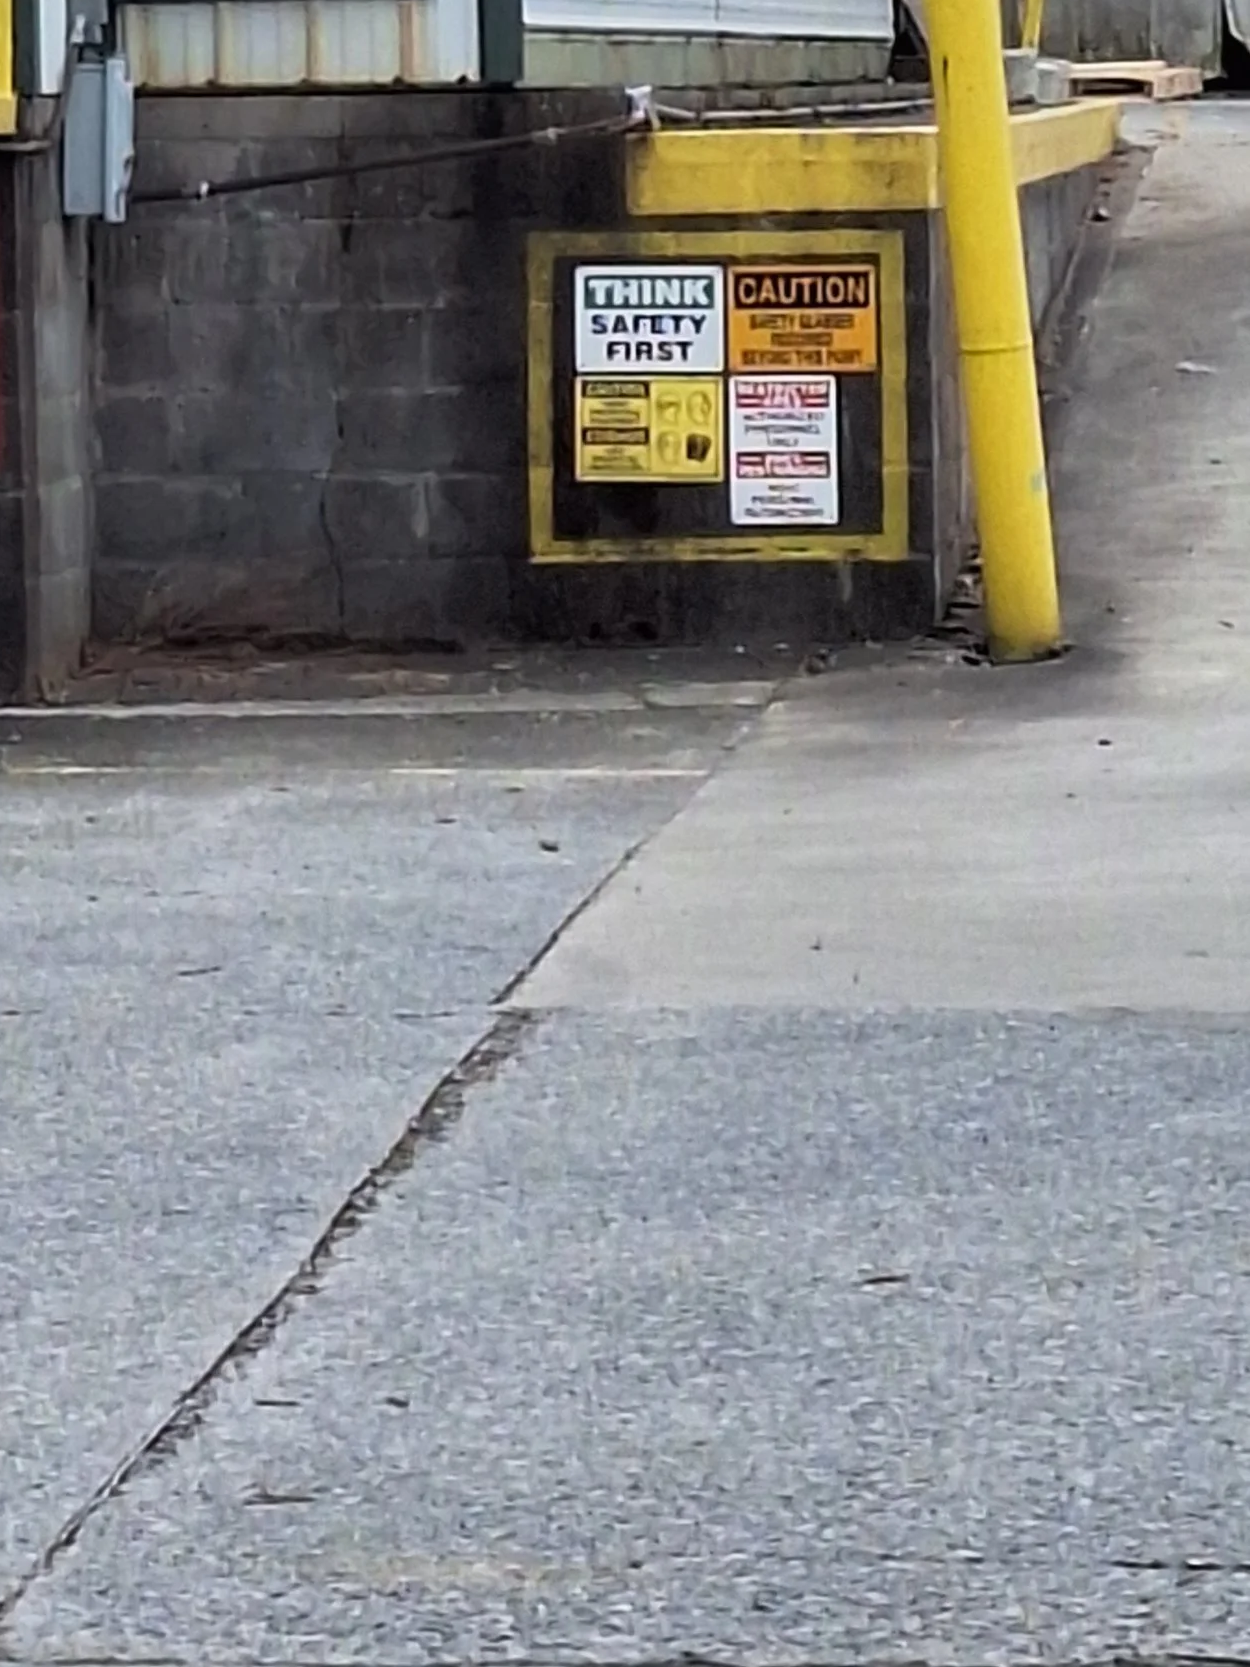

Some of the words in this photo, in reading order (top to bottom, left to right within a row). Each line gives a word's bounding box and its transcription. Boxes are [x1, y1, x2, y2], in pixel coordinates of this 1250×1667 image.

[588, 278, 710, 306] THINK
[738, 276, 866, 305] CAUTION
[591, 314, 707, 335] SAFETY
[606, 340, 694, 362] FIRST
